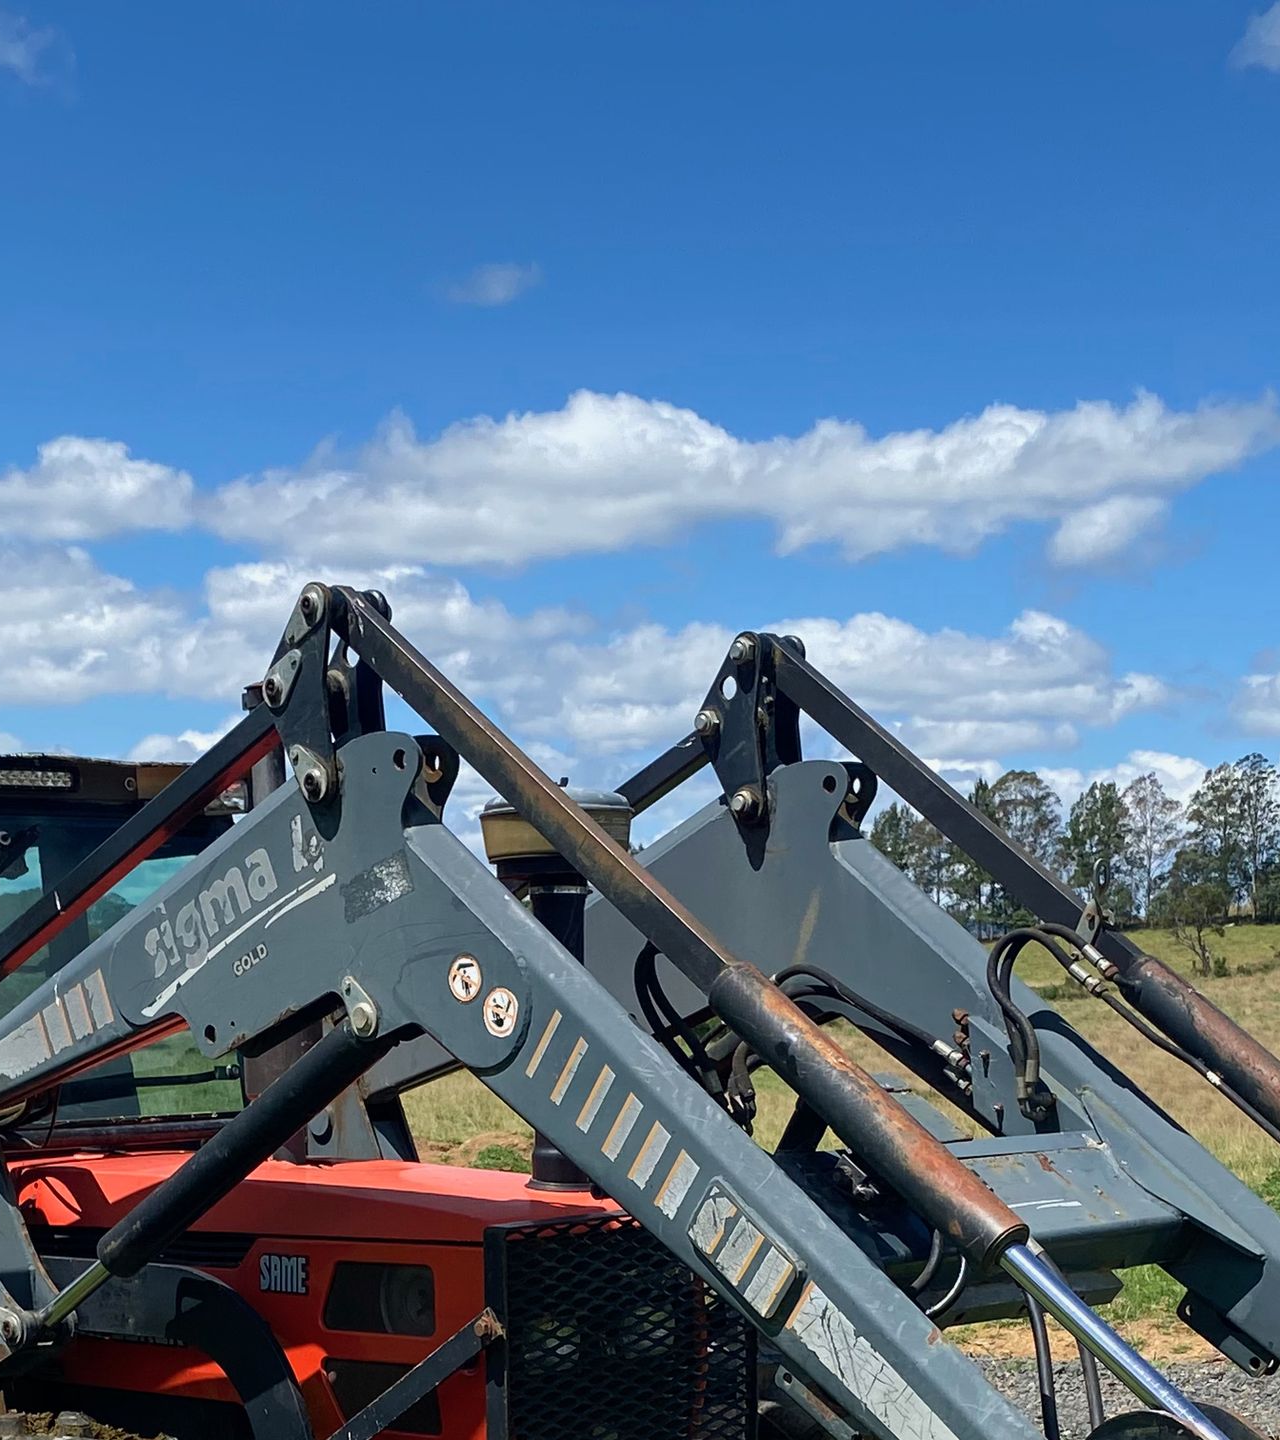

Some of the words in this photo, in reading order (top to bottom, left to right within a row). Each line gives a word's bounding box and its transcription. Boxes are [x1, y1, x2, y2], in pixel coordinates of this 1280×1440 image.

[144, 848, 278, 978] sigma
[233, 943, 268, 977] GOLD
[259, 1254, 308, 1294] SAME
